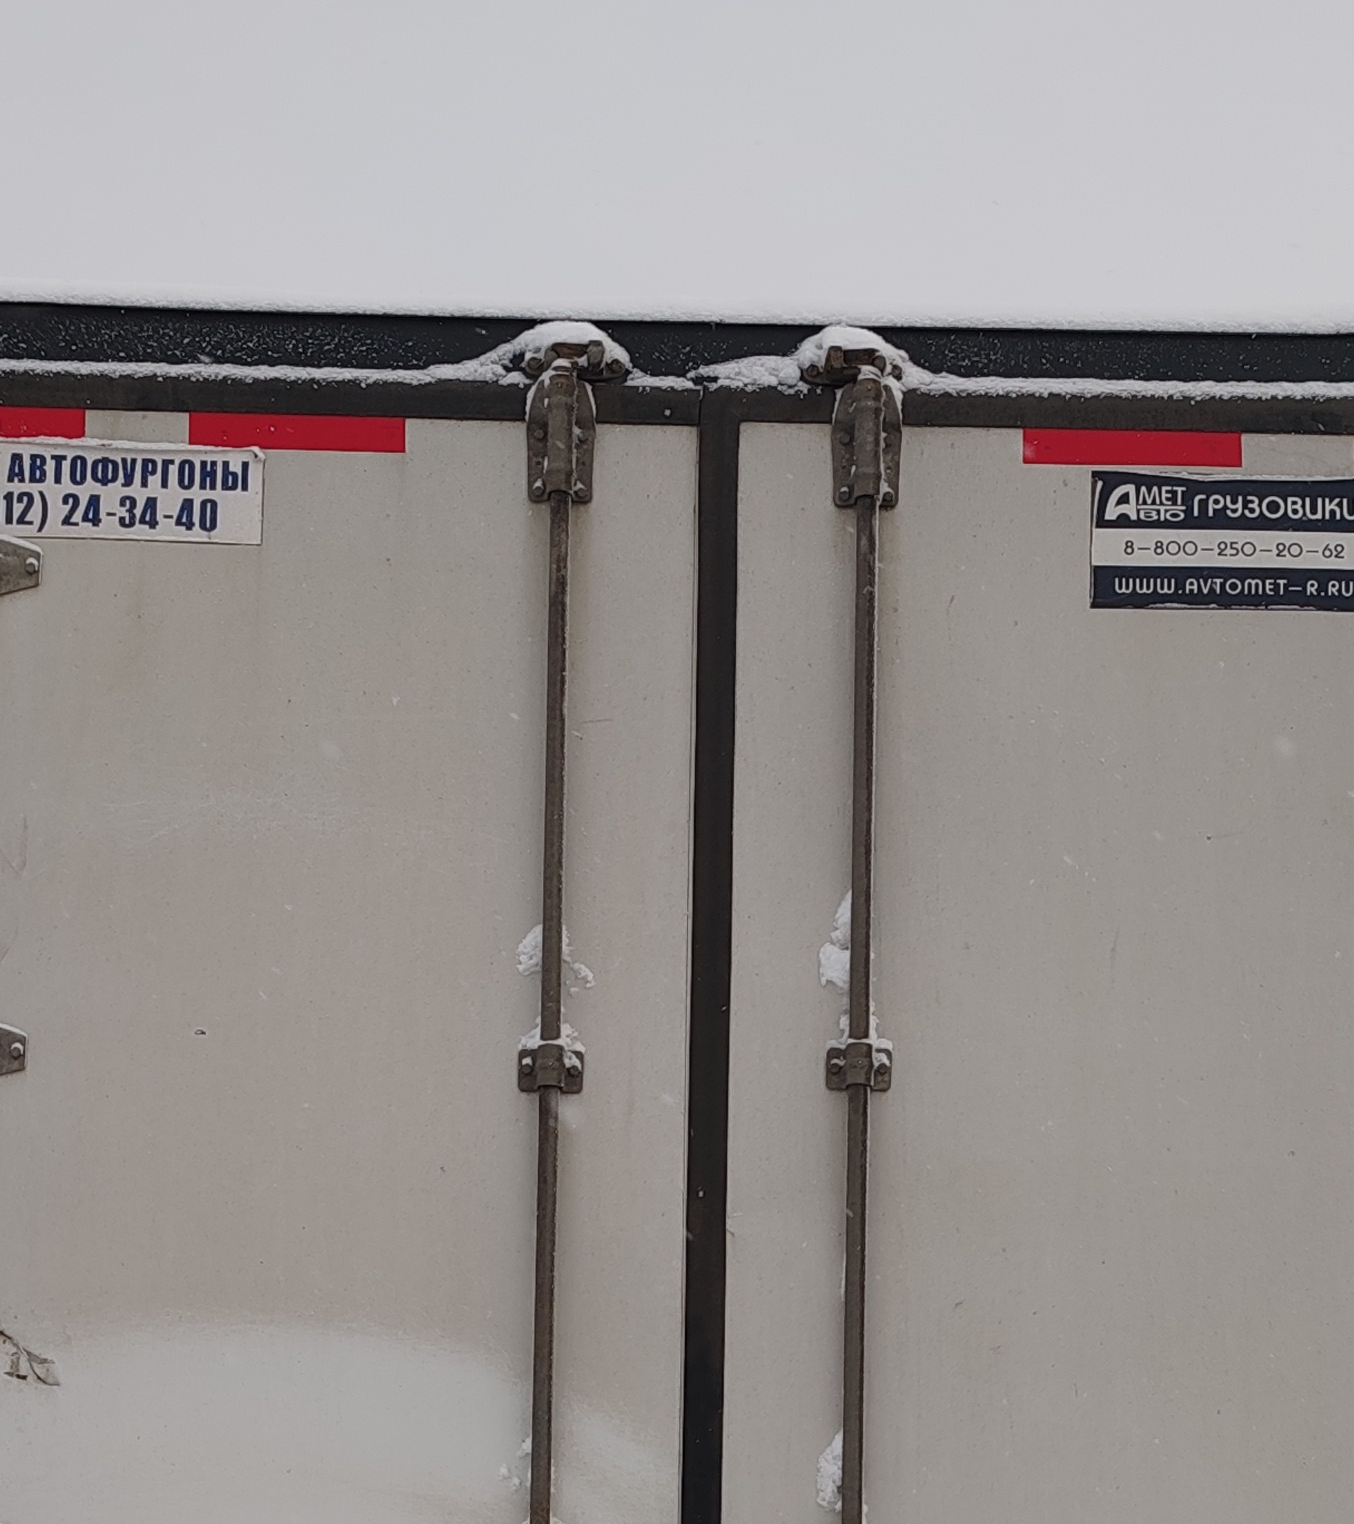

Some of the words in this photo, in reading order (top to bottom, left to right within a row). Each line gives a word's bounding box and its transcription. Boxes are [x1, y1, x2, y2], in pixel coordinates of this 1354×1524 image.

[7, 452, 250, 492] АВТОФУРГОНЫ
[61, 492, 219, 532] 24-34-40
[1123, 539, 1346, 560] 8-800-250-20-62
[1114, 576, 1354, 597] WWW.AVTOMET-R.RU
